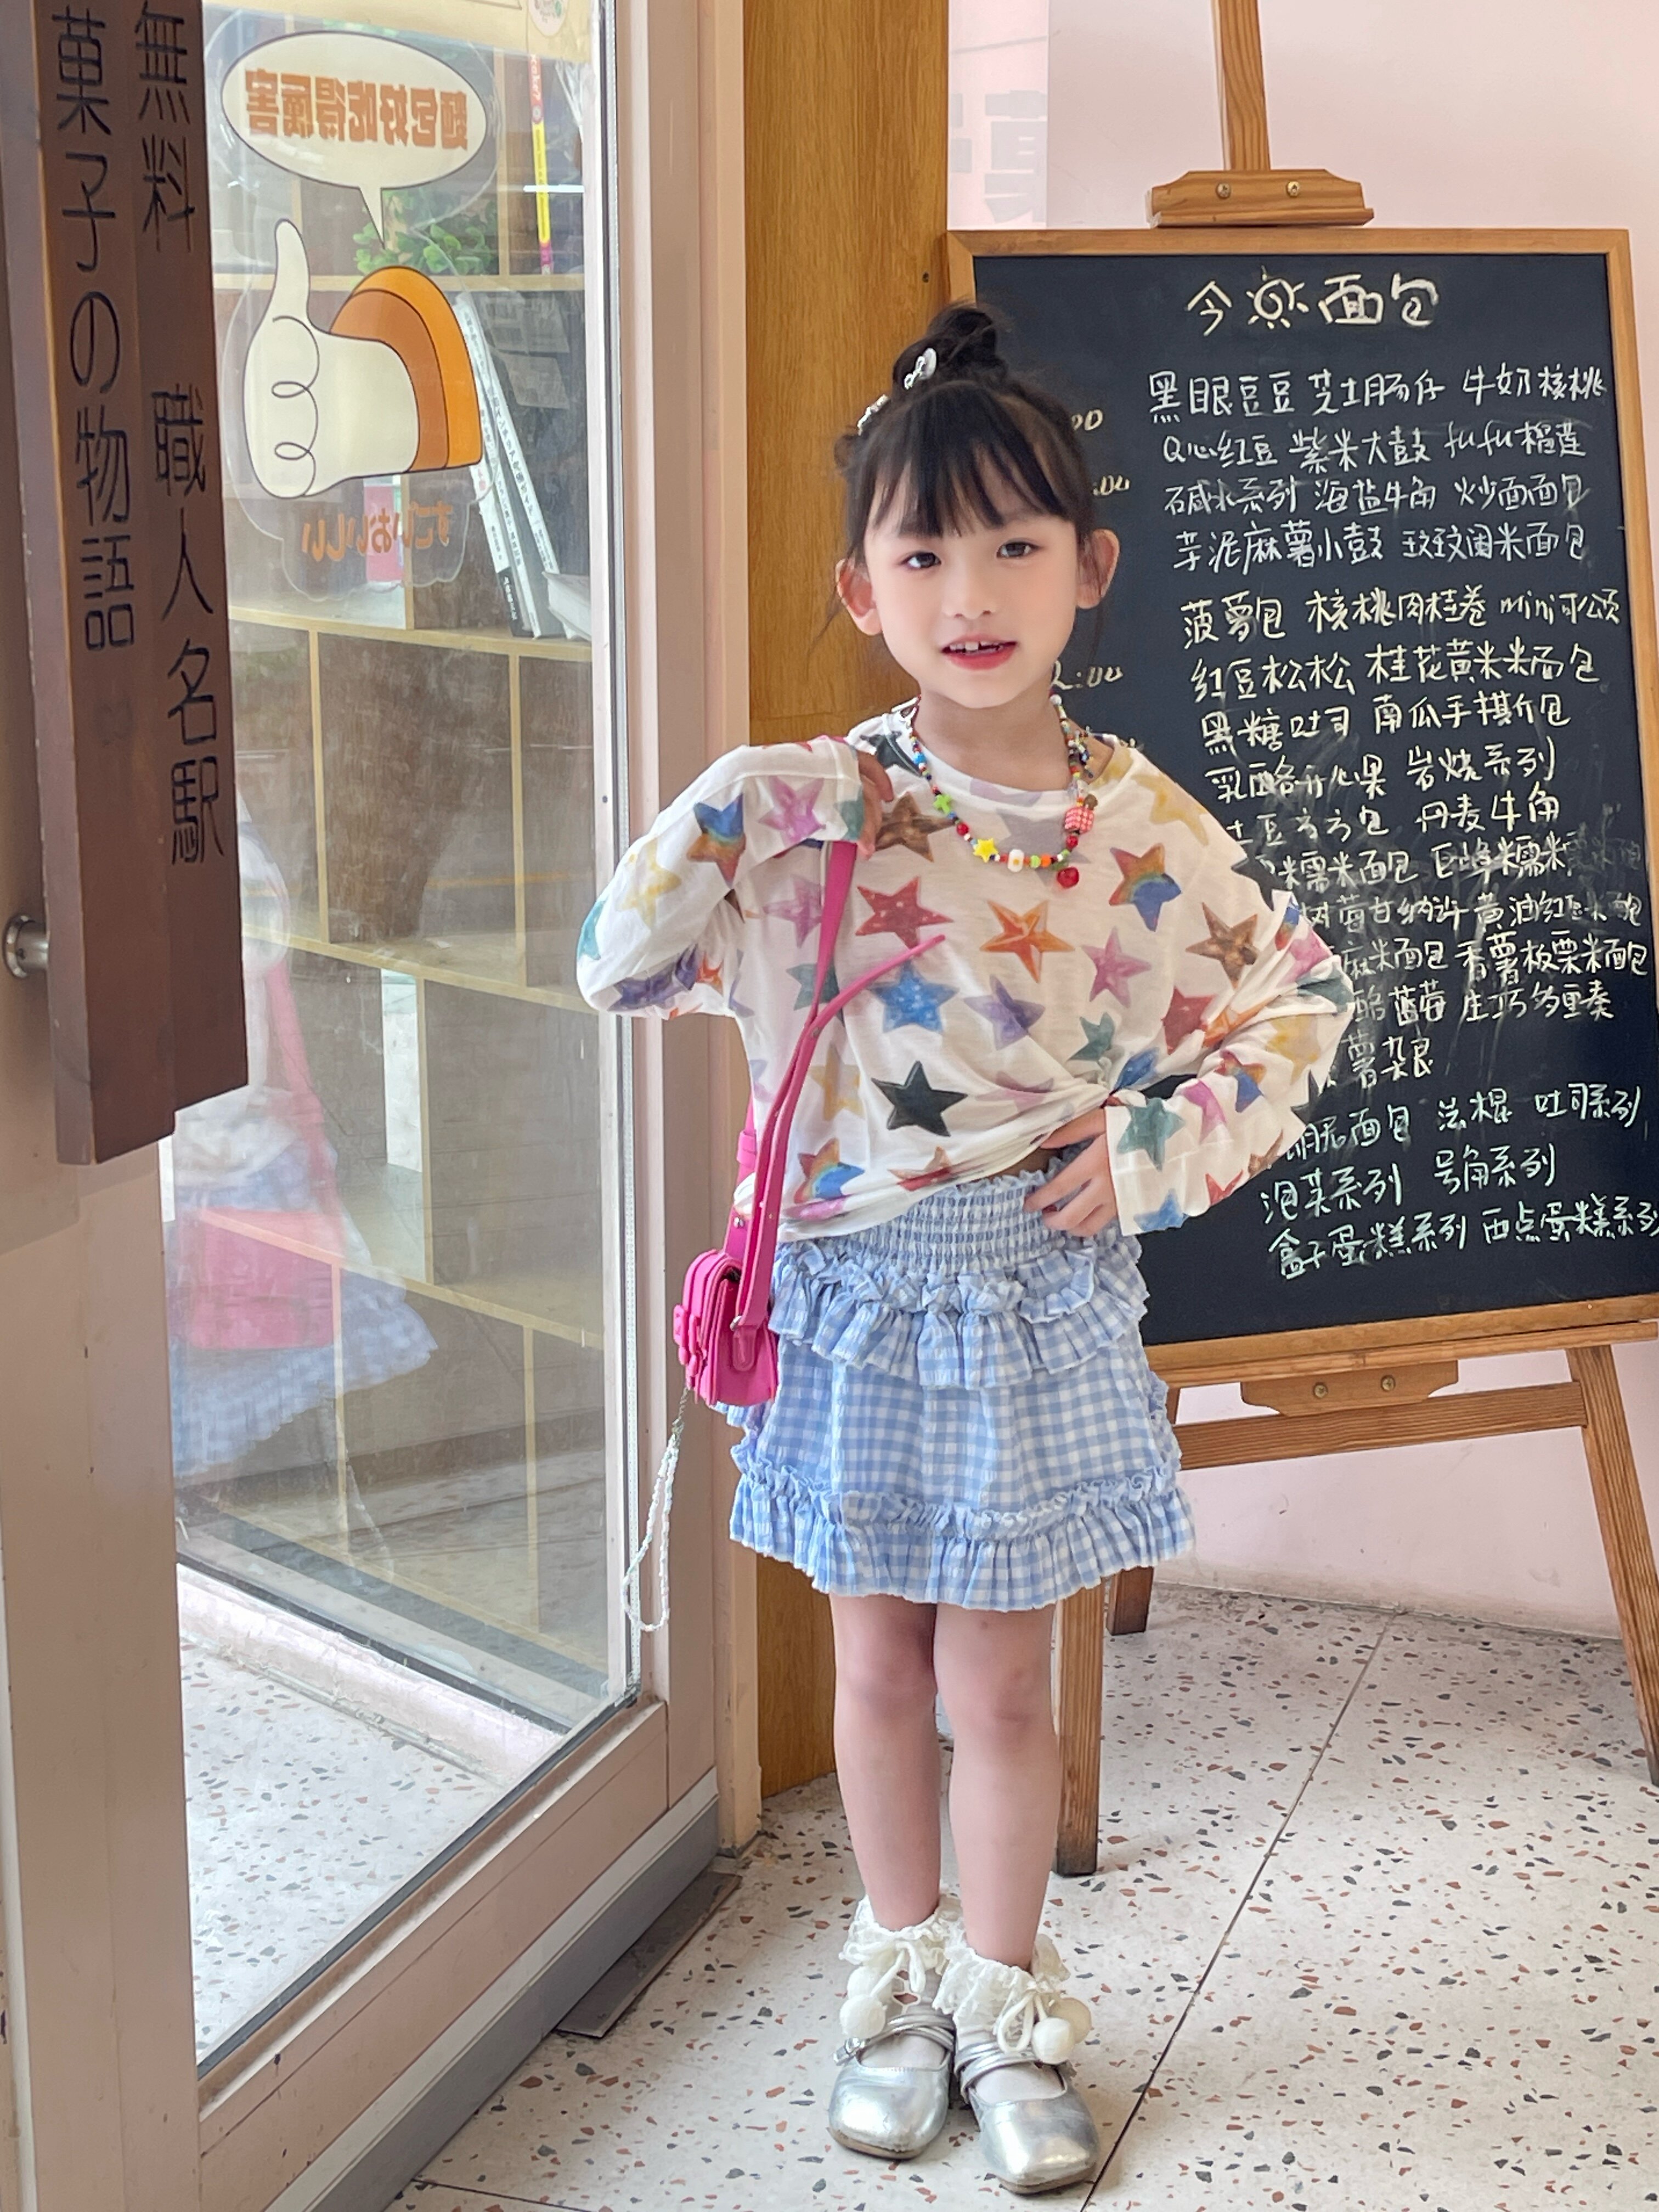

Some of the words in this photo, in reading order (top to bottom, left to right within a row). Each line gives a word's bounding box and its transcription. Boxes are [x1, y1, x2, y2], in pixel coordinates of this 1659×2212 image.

[133, 1, 195, 252] 無料
[52, 5, 134, 651] 菓子の物語
[1149, 370, 1295, 423] 黑眼豆豆
[1308, 368, 1446, 416] 芝士肠仔
[1463, 362, 1608, 407] 牛奶核桃
[1163, 429, 1278, 468] Q心红豆
[1288, 425, 1432, 475] 紫米大鼓
[1314, 476, 1437, 516] 海盐牛角
[1173, 520, 1384, 575] 芋泥麻薯小鼓
[151, 383, 224, 865] 職人名駅
[1180, 590, 1286, 650] 菠萝包
[1305, 584, 1487, 634] 核桃肉桂卷
[1190, 651, 1356, 703] 红豆松松
[1364, 635, 1600, 684] 桂花黄米米面包
[1201, 706, 1350, 755] 黑糖吐司
[1406, 735, 1555, 791] 岩烧系列
[1414, 781, 1560, 833] 丹麦牛角
[1328, 937, 1449, 980] 麻米面包
[1534, 1082, 1641, 1127] 吐司系列
[1434, 1142, 1556, 1195] 号角系列
[1268, 1211, 1466, 1279] 盒子蛋糕系列
